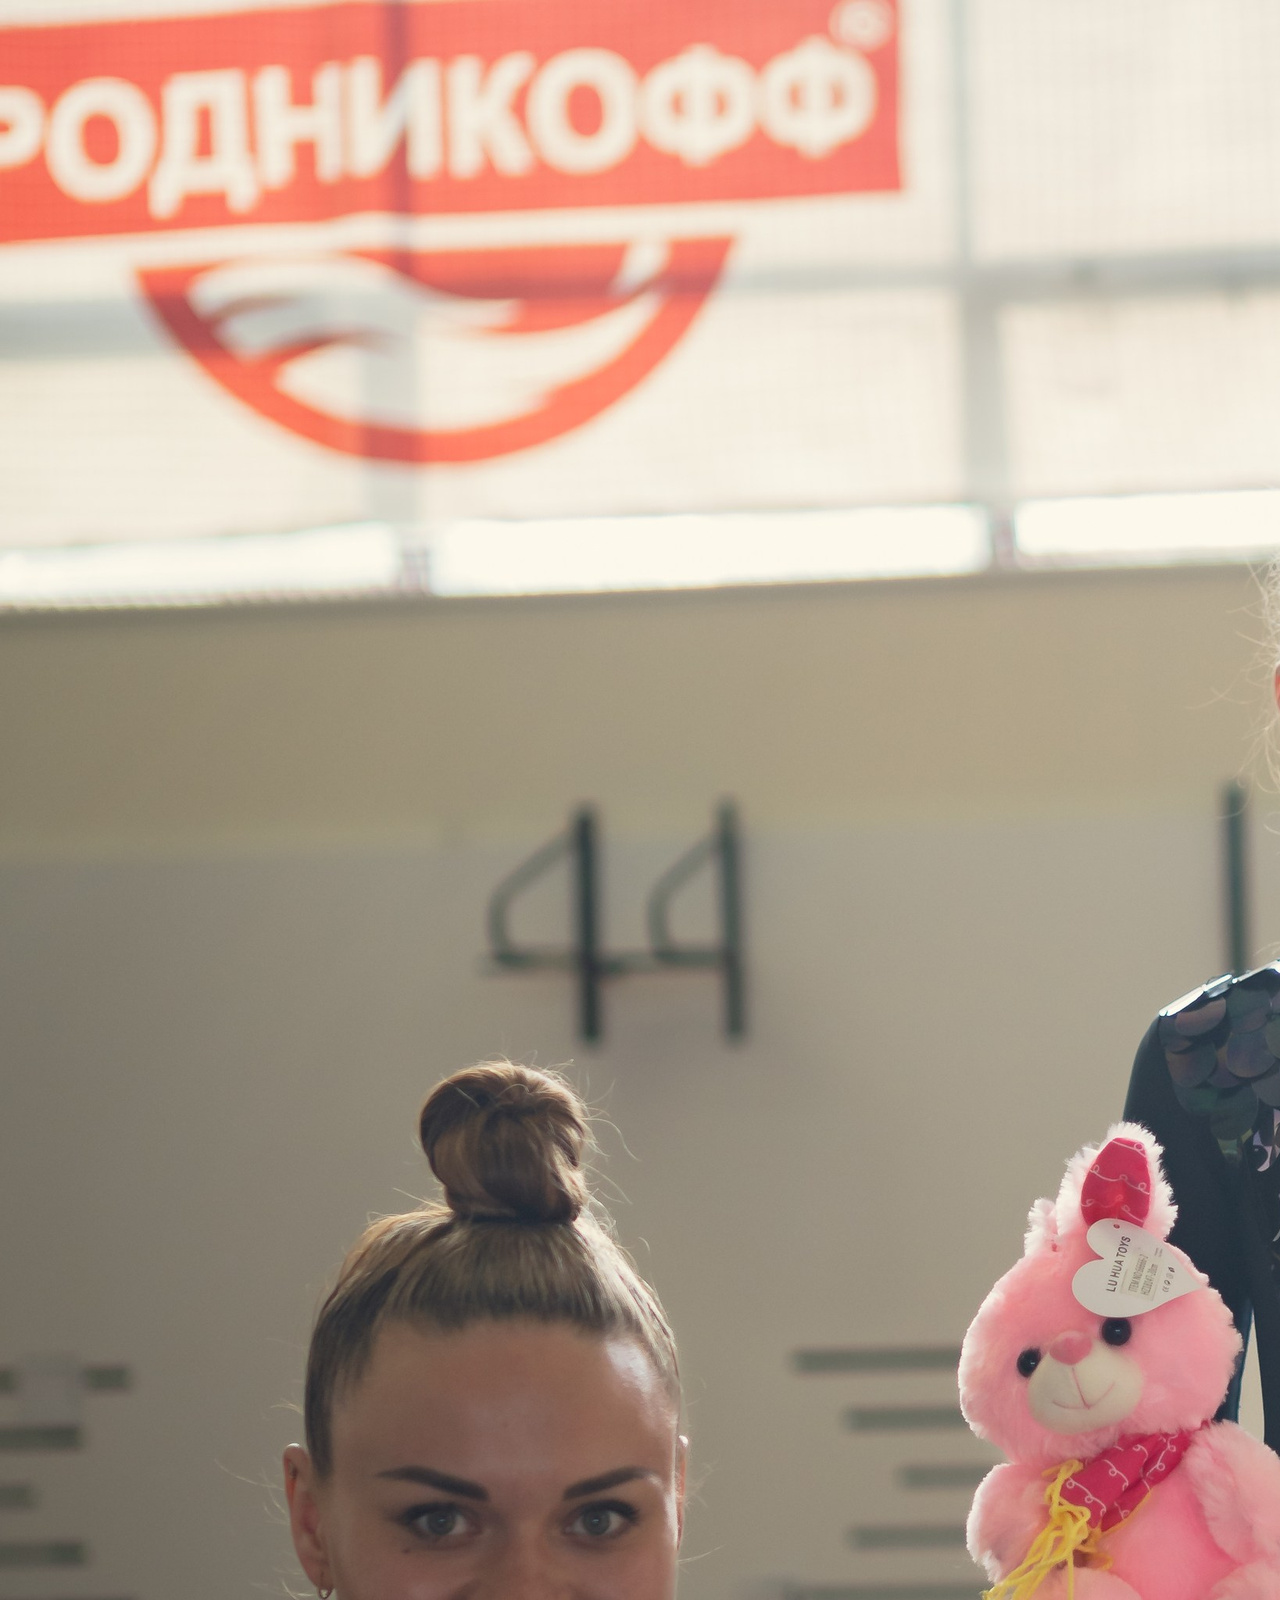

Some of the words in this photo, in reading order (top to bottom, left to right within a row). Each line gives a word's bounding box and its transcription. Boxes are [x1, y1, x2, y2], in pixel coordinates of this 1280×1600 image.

[1116, 1236, 1131, 1258] TOYS
[1110, 1259, 1124, 1279] HUA
[1105, 1279, 1118, 1292] LU
